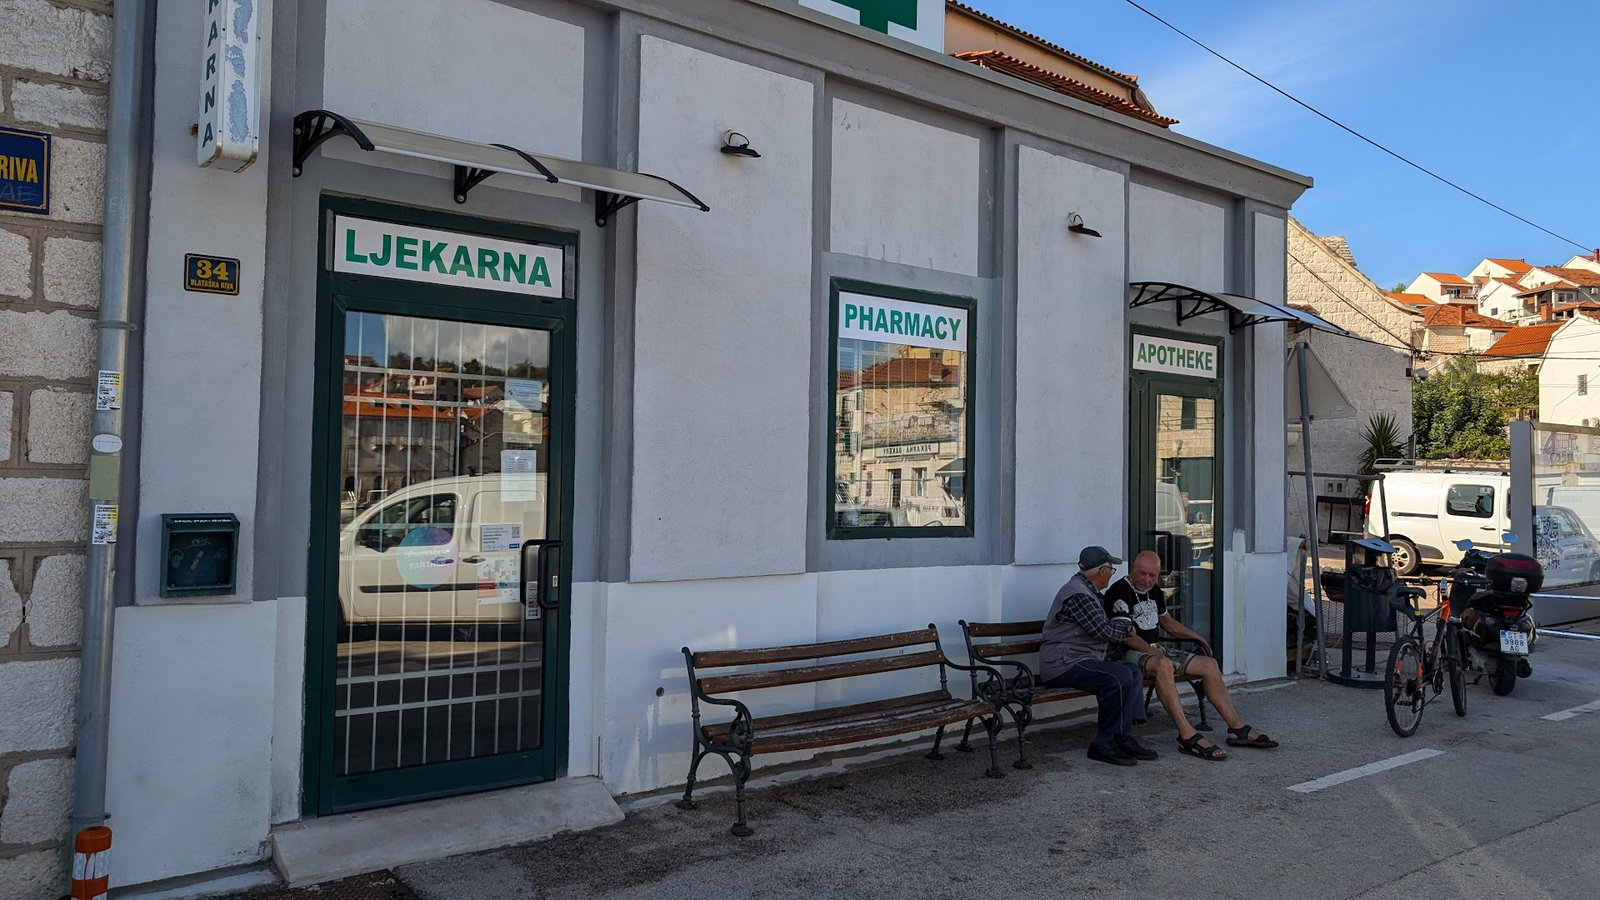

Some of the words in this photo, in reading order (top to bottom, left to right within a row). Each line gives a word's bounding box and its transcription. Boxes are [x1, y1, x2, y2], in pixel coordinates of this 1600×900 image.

[0, 155, 39, 184] RIVA
[196, 259, 229, 281] 34
[345, 228, 552, 288] LJEKARNA
[190, 279, 220, 288] BLATAŠKA
[220, 282, 234, 290] RIVA
[844, 303, 961, 342] PHARMACY
[1137, 342, 1213, 371] APOTHEKE
[1504, 638, 1524, 647] 9988
[1507, 631, 1518, 639] ST
